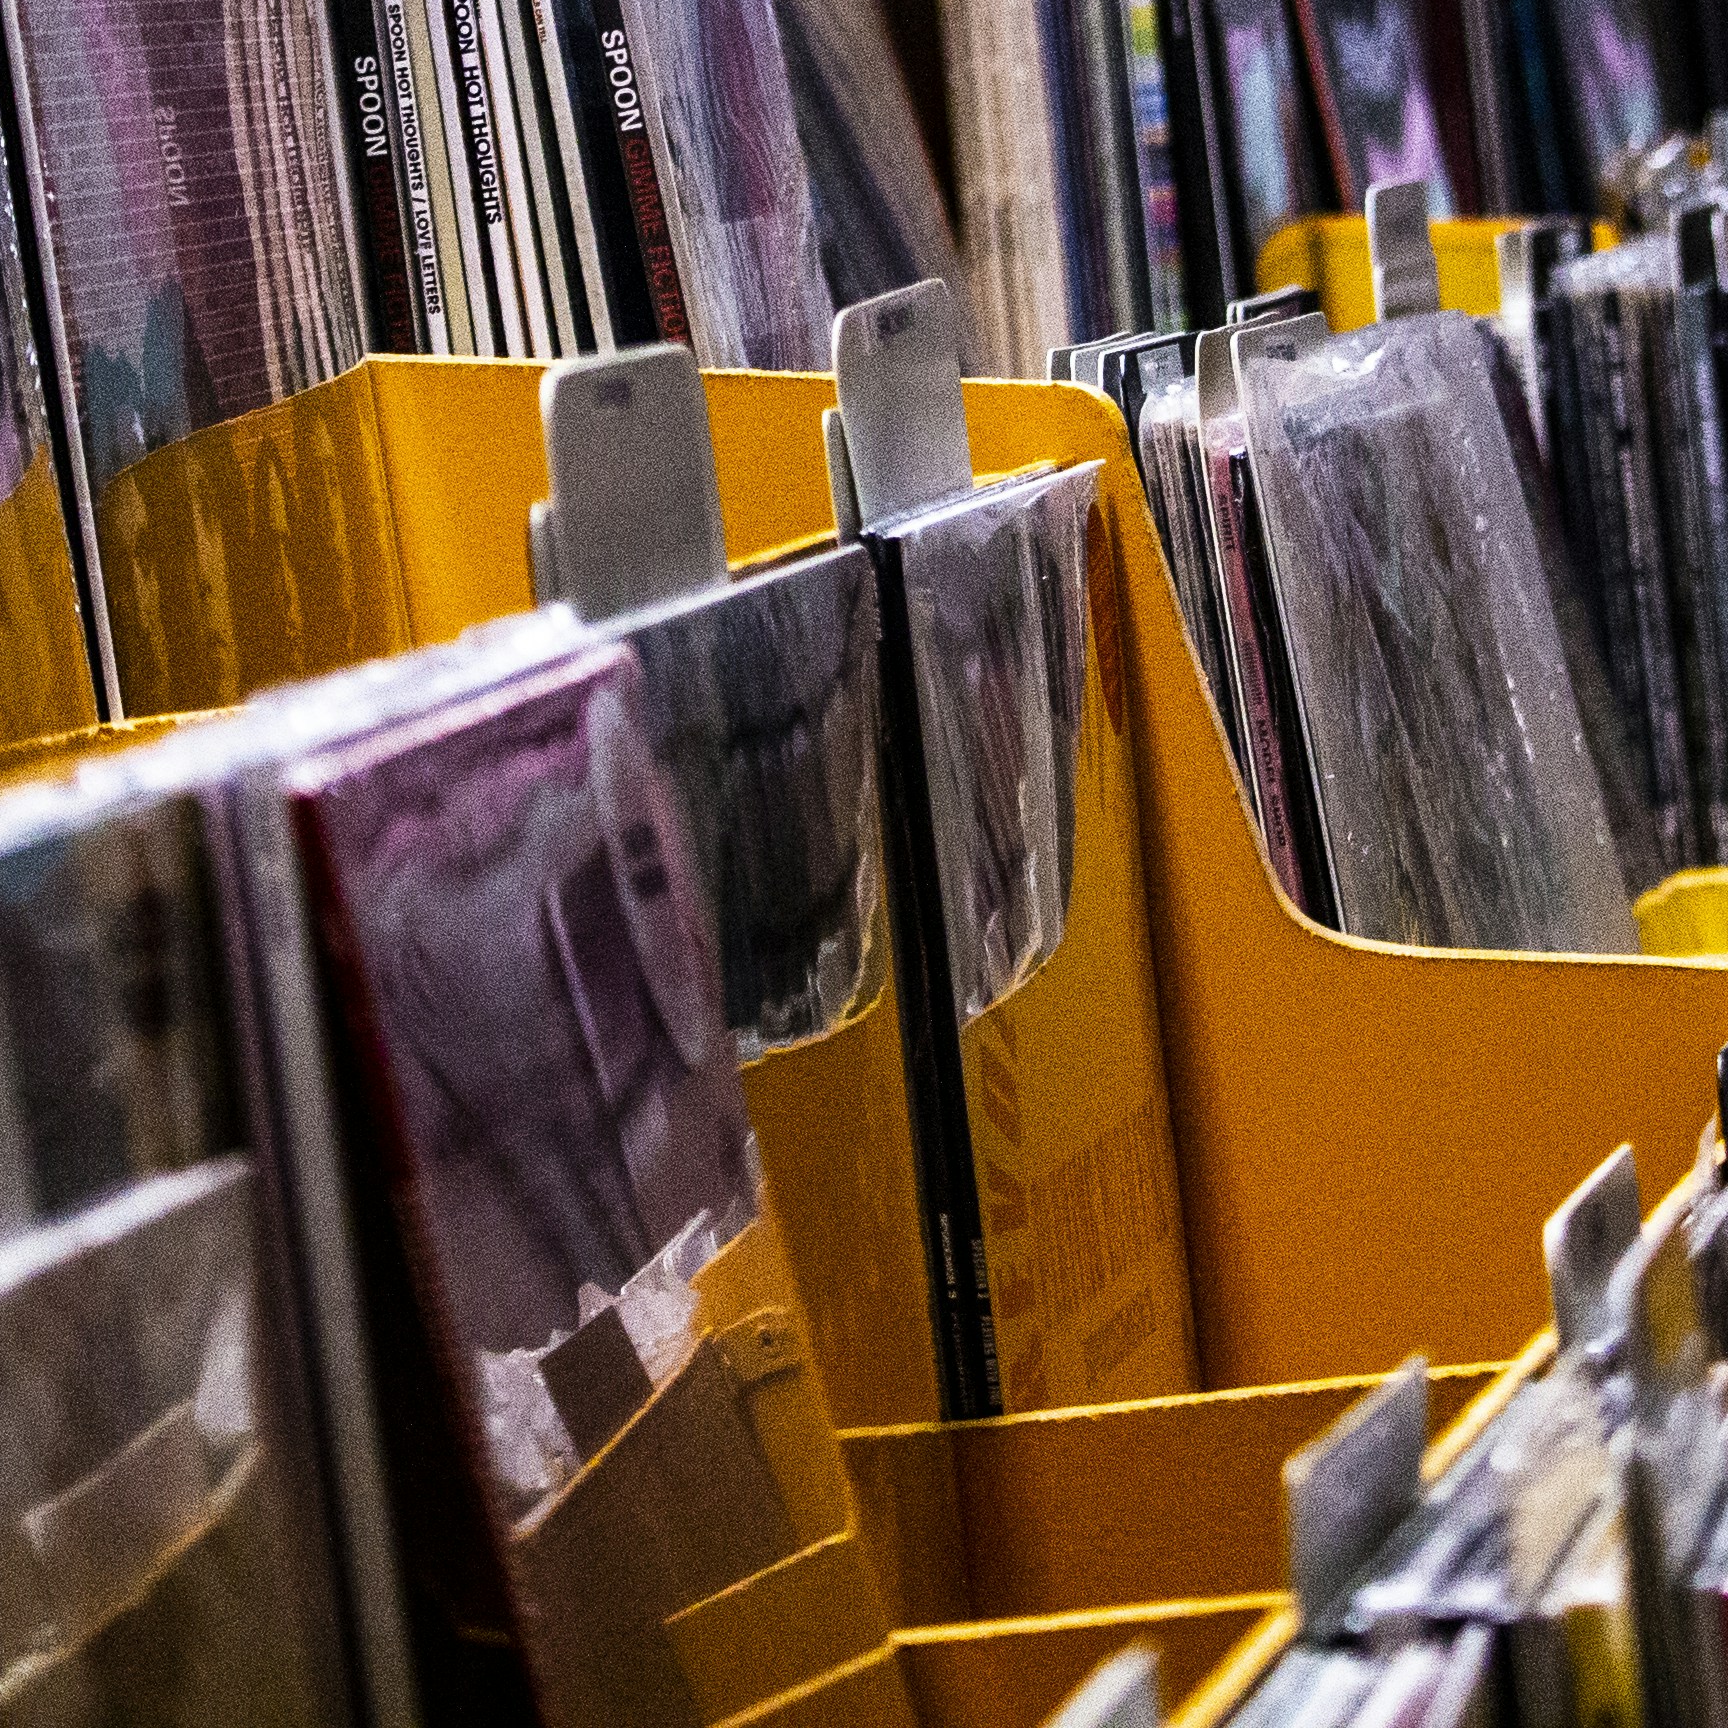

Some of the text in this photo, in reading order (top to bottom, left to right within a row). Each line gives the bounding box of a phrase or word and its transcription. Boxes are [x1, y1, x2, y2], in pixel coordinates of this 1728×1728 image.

[387, 4, 409, 60] SPOON
[353, 56, 388, 157] SPOON
[396, 64, 414, 99] HOT
[463, 66, 485, 110] HOT
[401, 100, 425, 191] THOUGHTS
[469, 111, 503, 225] THOUGHTS
[601, 29, 644, 132] SPOON
[624, 139, 662, 240] GIMME
[415, 209, 433, 250] LOVE
[421, 253, 442, 315] LETTERS
[1218, 493, 1287, 849] SPIRIT MODEL SHOP
